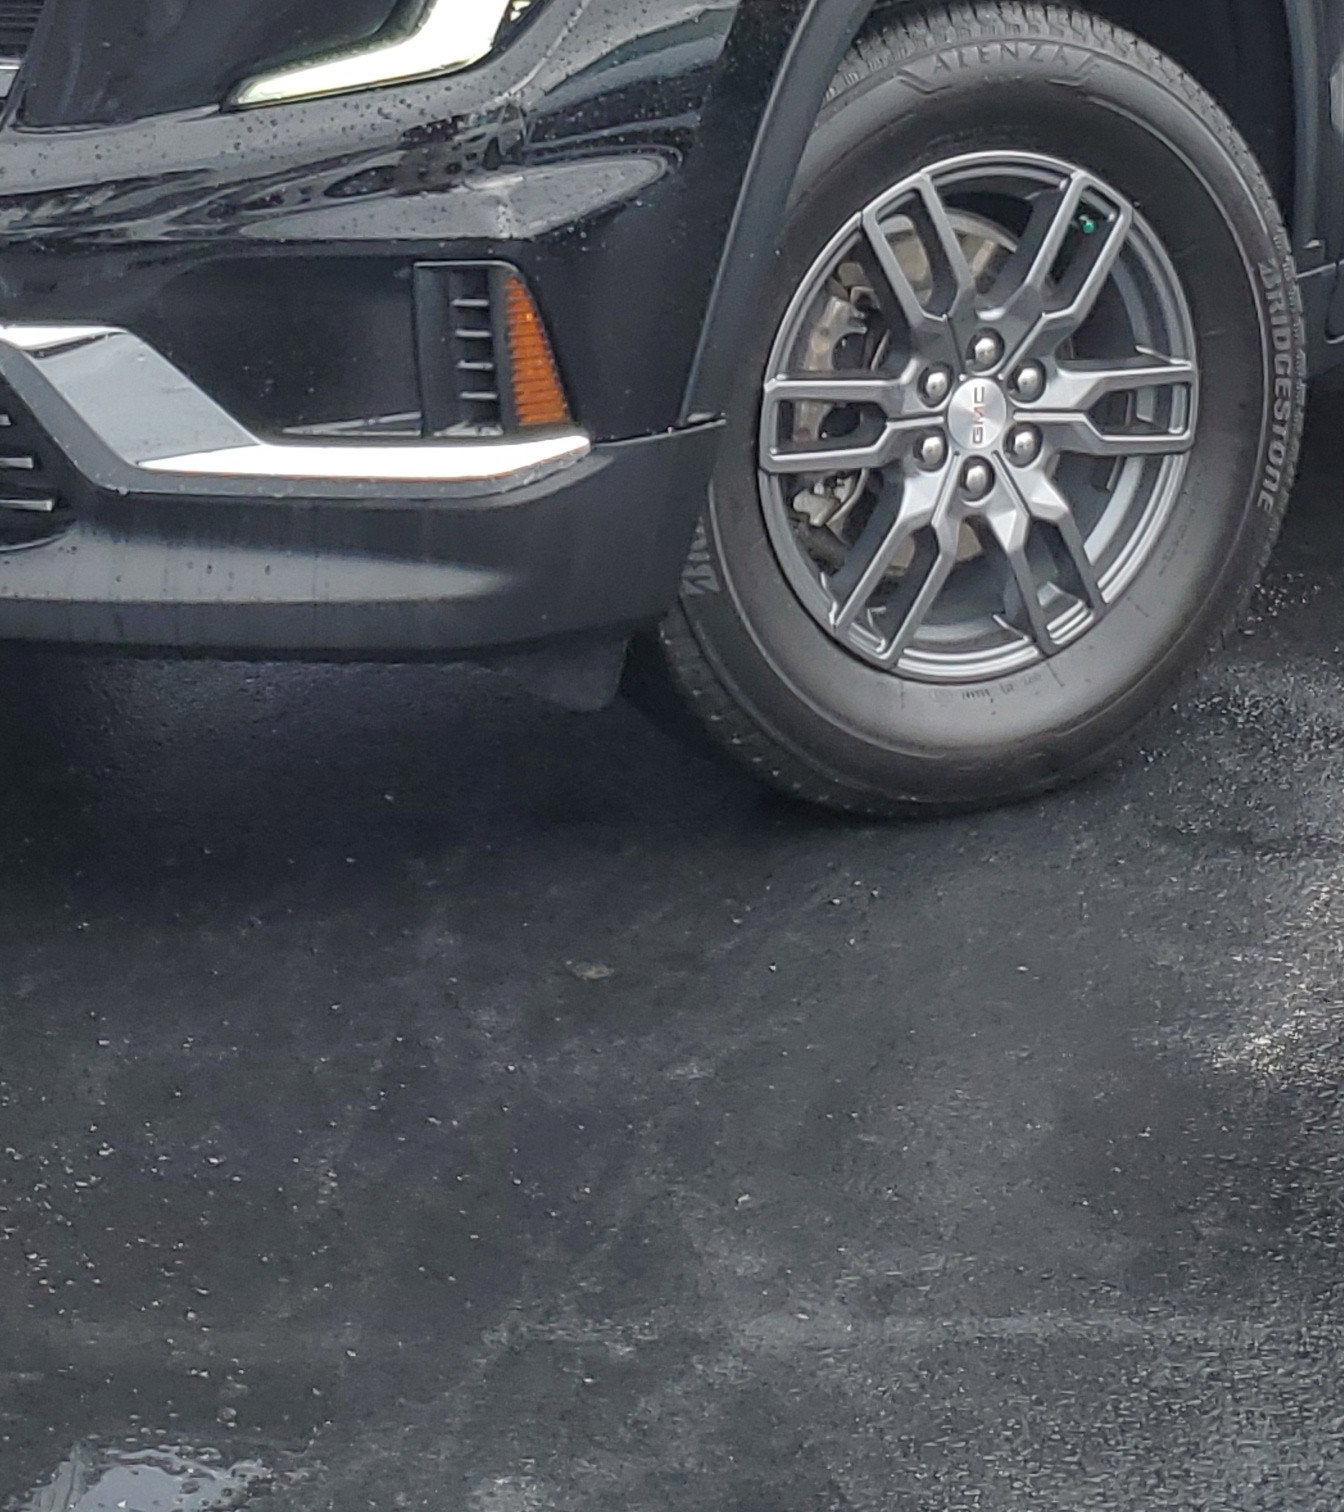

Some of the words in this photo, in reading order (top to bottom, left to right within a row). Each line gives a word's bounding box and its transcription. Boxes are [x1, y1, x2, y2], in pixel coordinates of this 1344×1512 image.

[931, 42, 1069, 74] ALENZA
[972, 386, 986, 445] GMC
[1257, 257, 1293, 515] BRIDGESTONE
